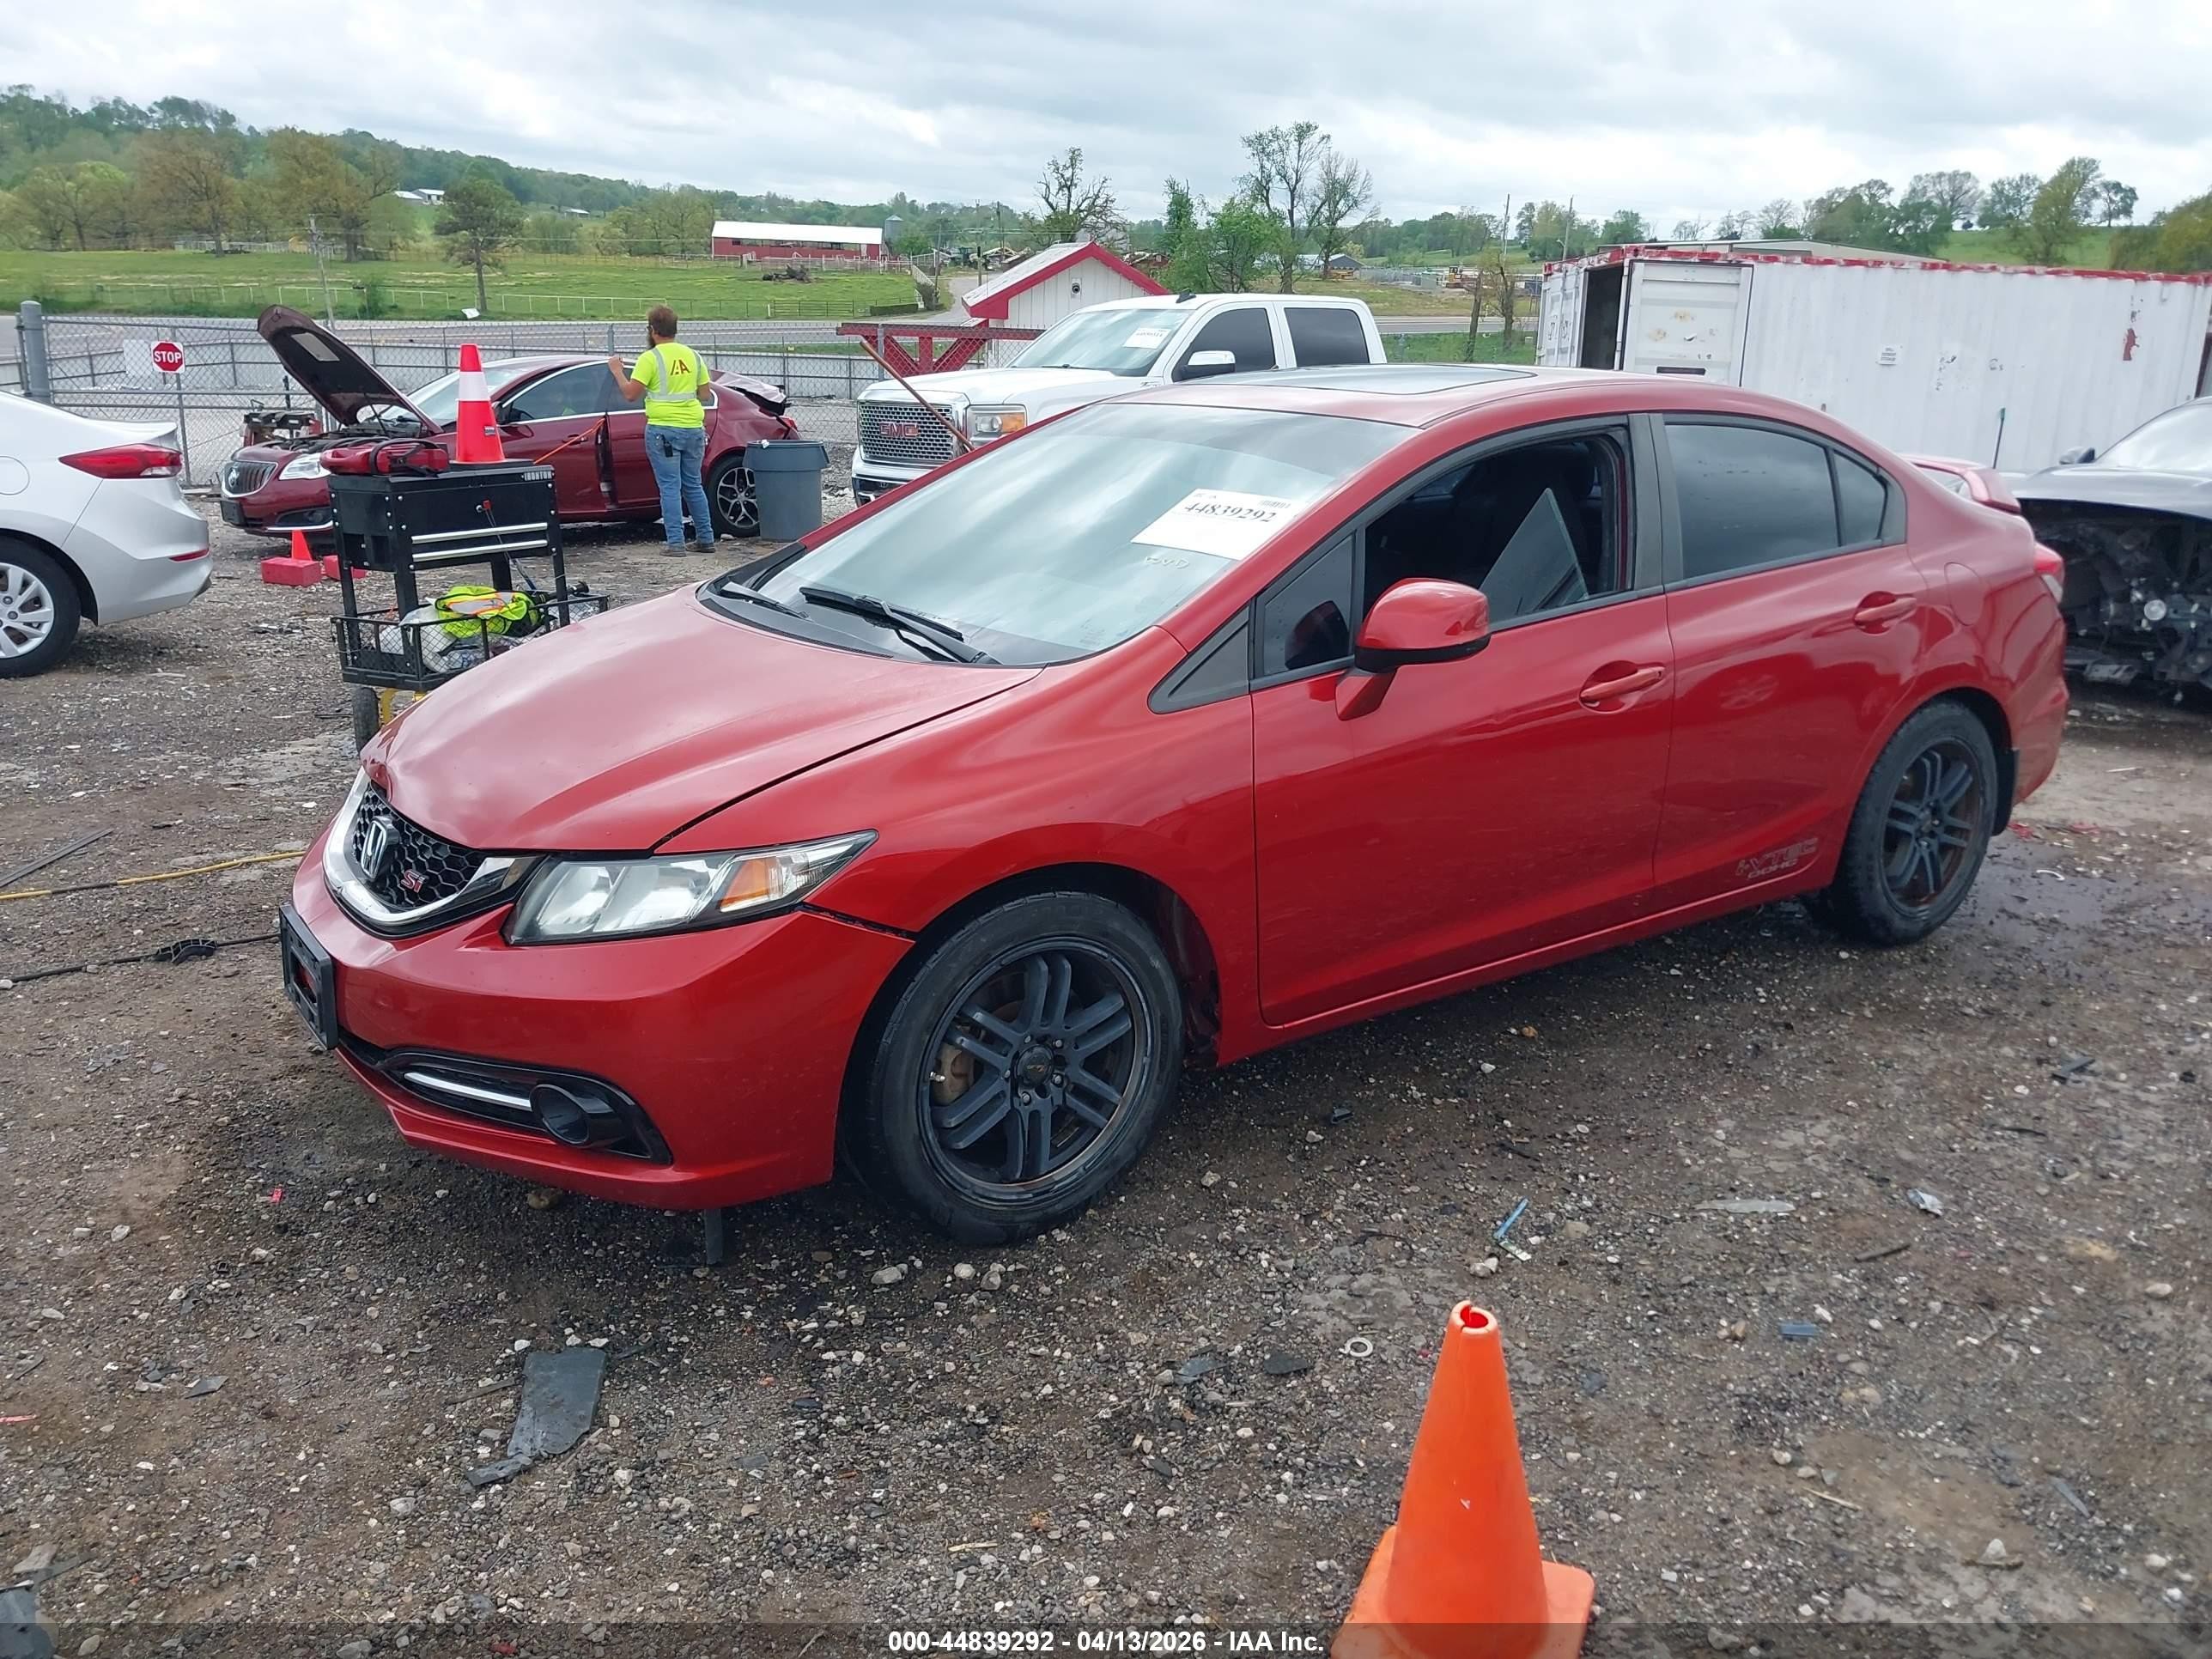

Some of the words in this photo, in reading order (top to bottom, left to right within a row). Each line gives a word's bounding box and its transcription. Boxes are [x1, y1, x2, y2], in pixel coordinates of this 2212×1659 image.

[155, 350, 182, 364] STOP
[878, 421, 920, 440] GMC
[1184, 501, 1278, 523] 44839292
[400, 869, 426, 893] Si
